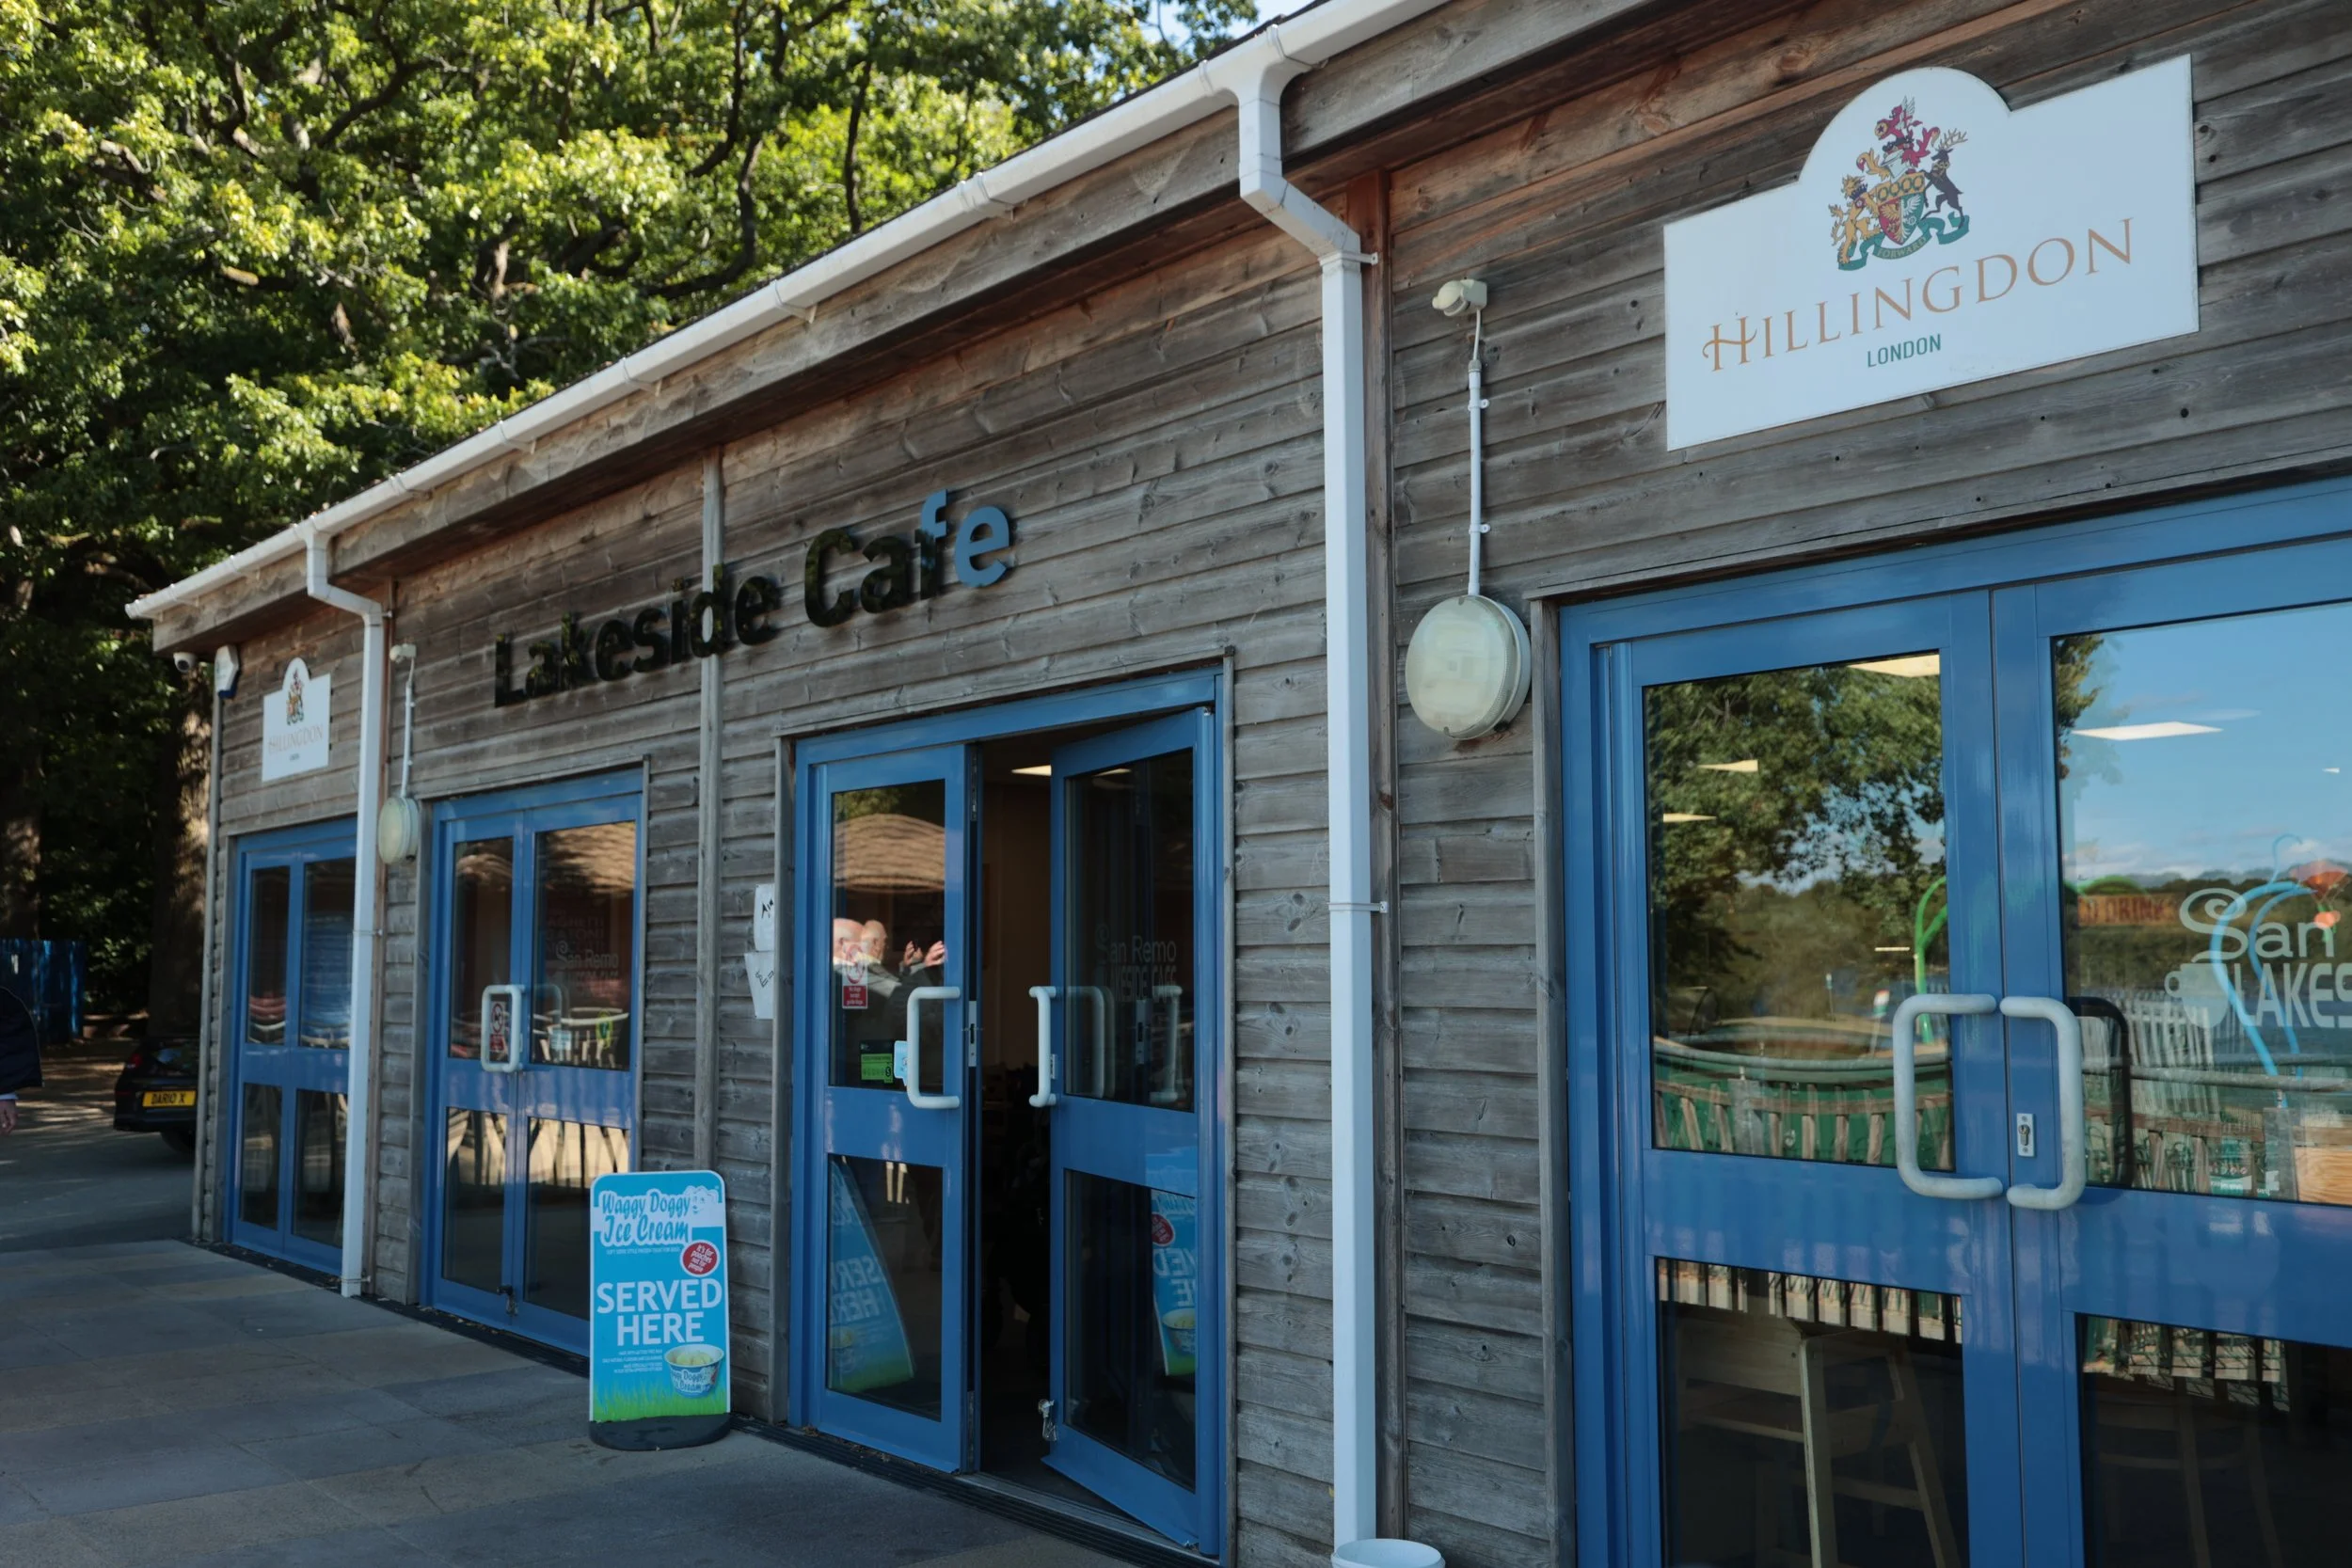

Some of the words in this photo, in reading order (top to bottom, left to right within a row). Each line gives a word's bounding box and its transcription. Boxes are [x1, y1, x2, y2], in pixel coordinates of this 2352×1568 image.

[1876, 235, 1928, 259] FORWARD
[1701, 217, 2135, 372] HILLINGDON
[1867, 332, 1942, 368] LONDON
[494, 563, 782, 707] Lakeside
[804, 488, 1013, 628] Cafe
[2179, 887, 2336, 962] San
[556, 941, 581, 970] San
[585, 949, 619, 969] Remo
[1094, 923, 1127, 964] San
[1132, 935, 1177, 962] Remo
[602, 1193, 647, 1219] Waggy
[649, 1191, 691, 1218] Doggy
[604, 1214, 631, 1243] Ice
[637, 1213, 690, 1243] Cream
[596, 1278, 723, 1314] SERVED
[616, 1311, 705, 1347] HERE
